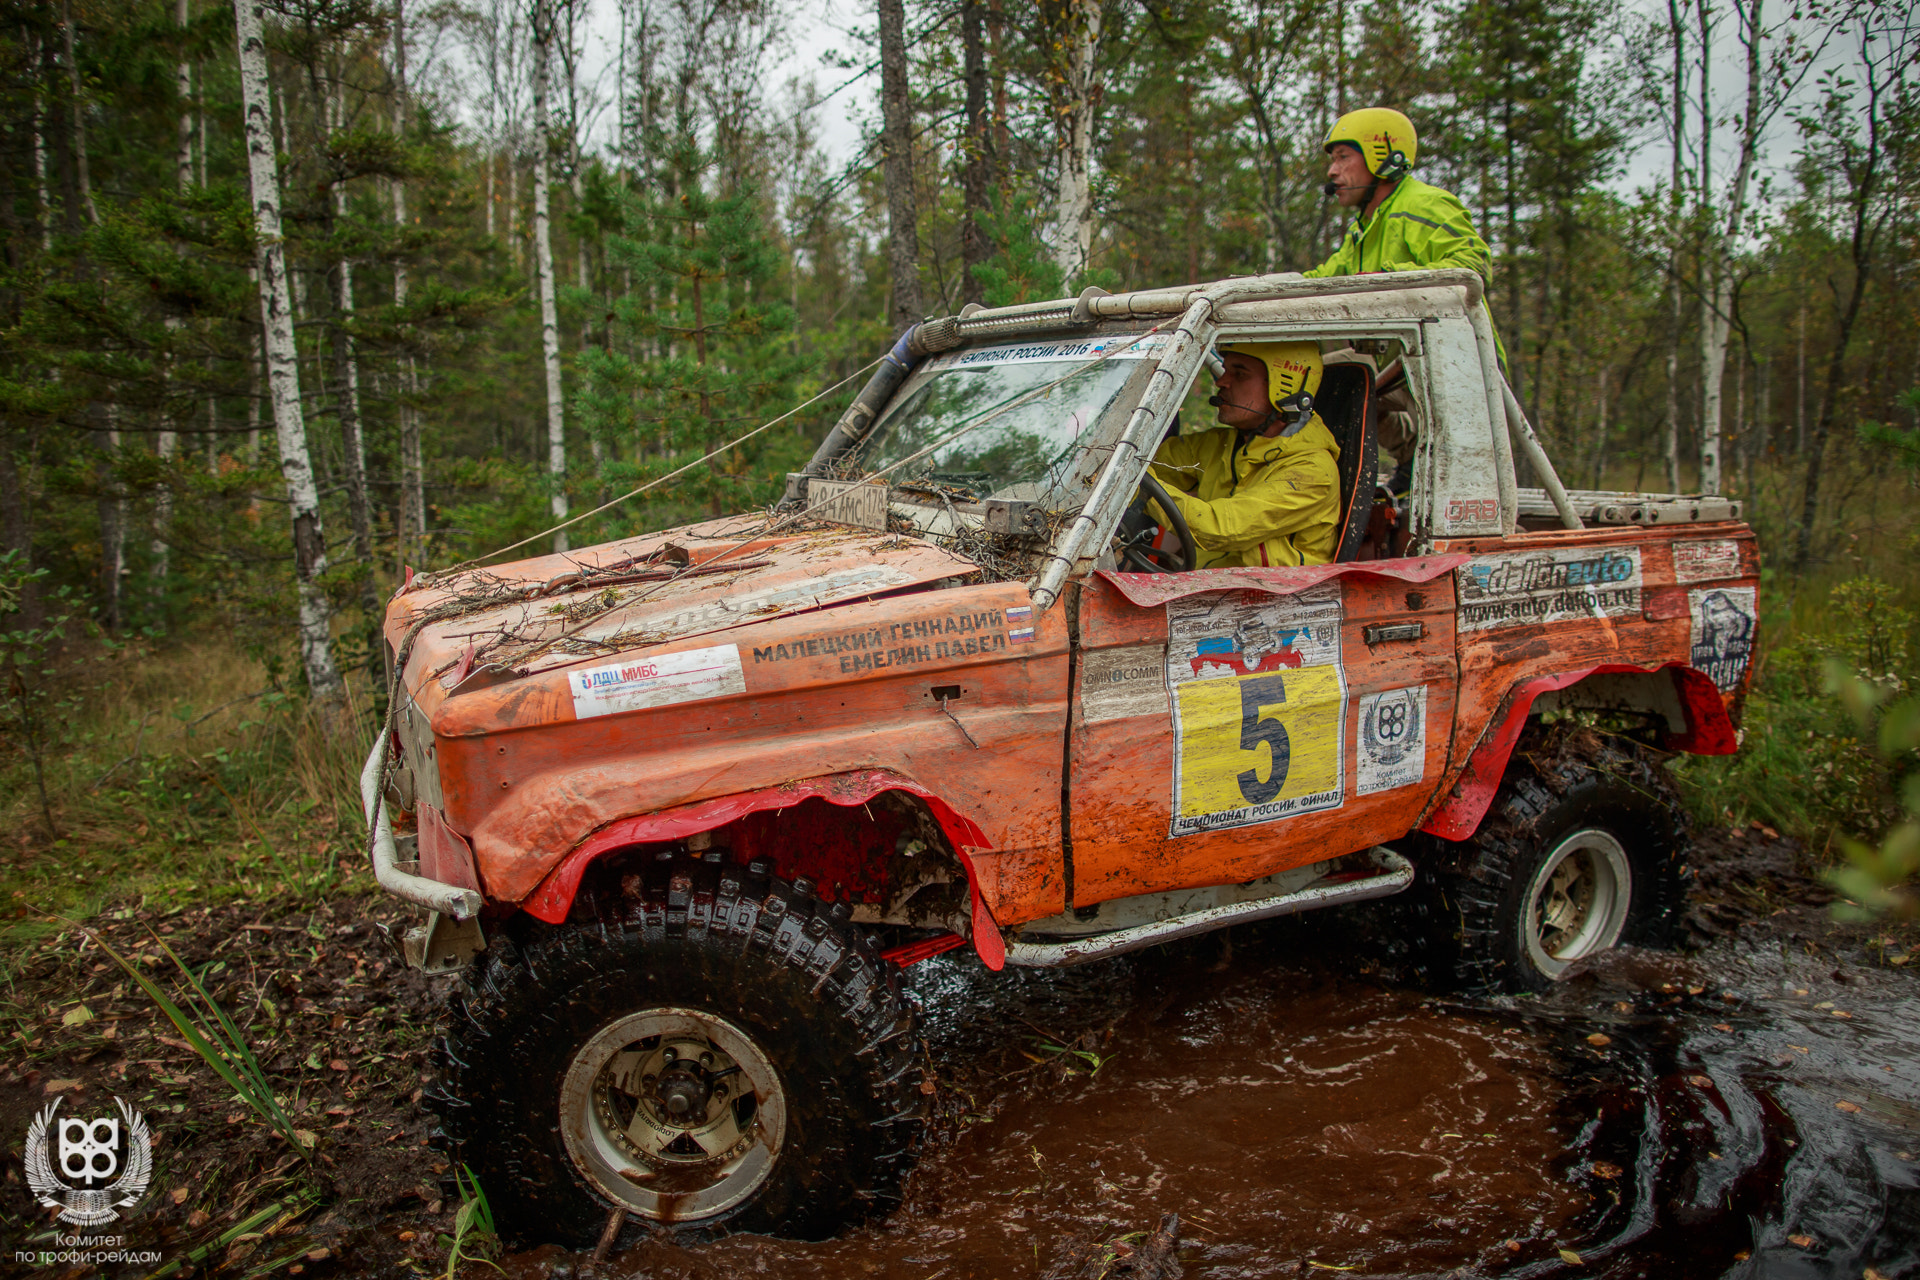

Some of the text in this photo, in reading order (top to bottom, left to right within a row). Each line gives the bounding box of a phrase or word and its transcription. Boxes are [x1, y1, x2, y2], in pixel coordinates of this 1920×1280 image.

[961, 349, 1016, 364] ЧЕМПИОНАТ
[1015, 346, 1058, 359] РОССИИ
[1058, 343, 1091, 356] 2016
[753, 608, 1003, 663] МАЛЕЦКИЙ ГЕННАДИЙ
[839, 633, 1006, 674] ЕМЕЛИН ПАВЕЛ
[593, 664, 658, 687] ЛДЦ МИБС
[1236, 675, 1290, 804] 5
[1376, 768, 1406, 779] Комитет
[1178, 808, 1247, 830] ЧЕМПИОНАТ
[1301, 790, 1338, 807] ФИНАЛ
